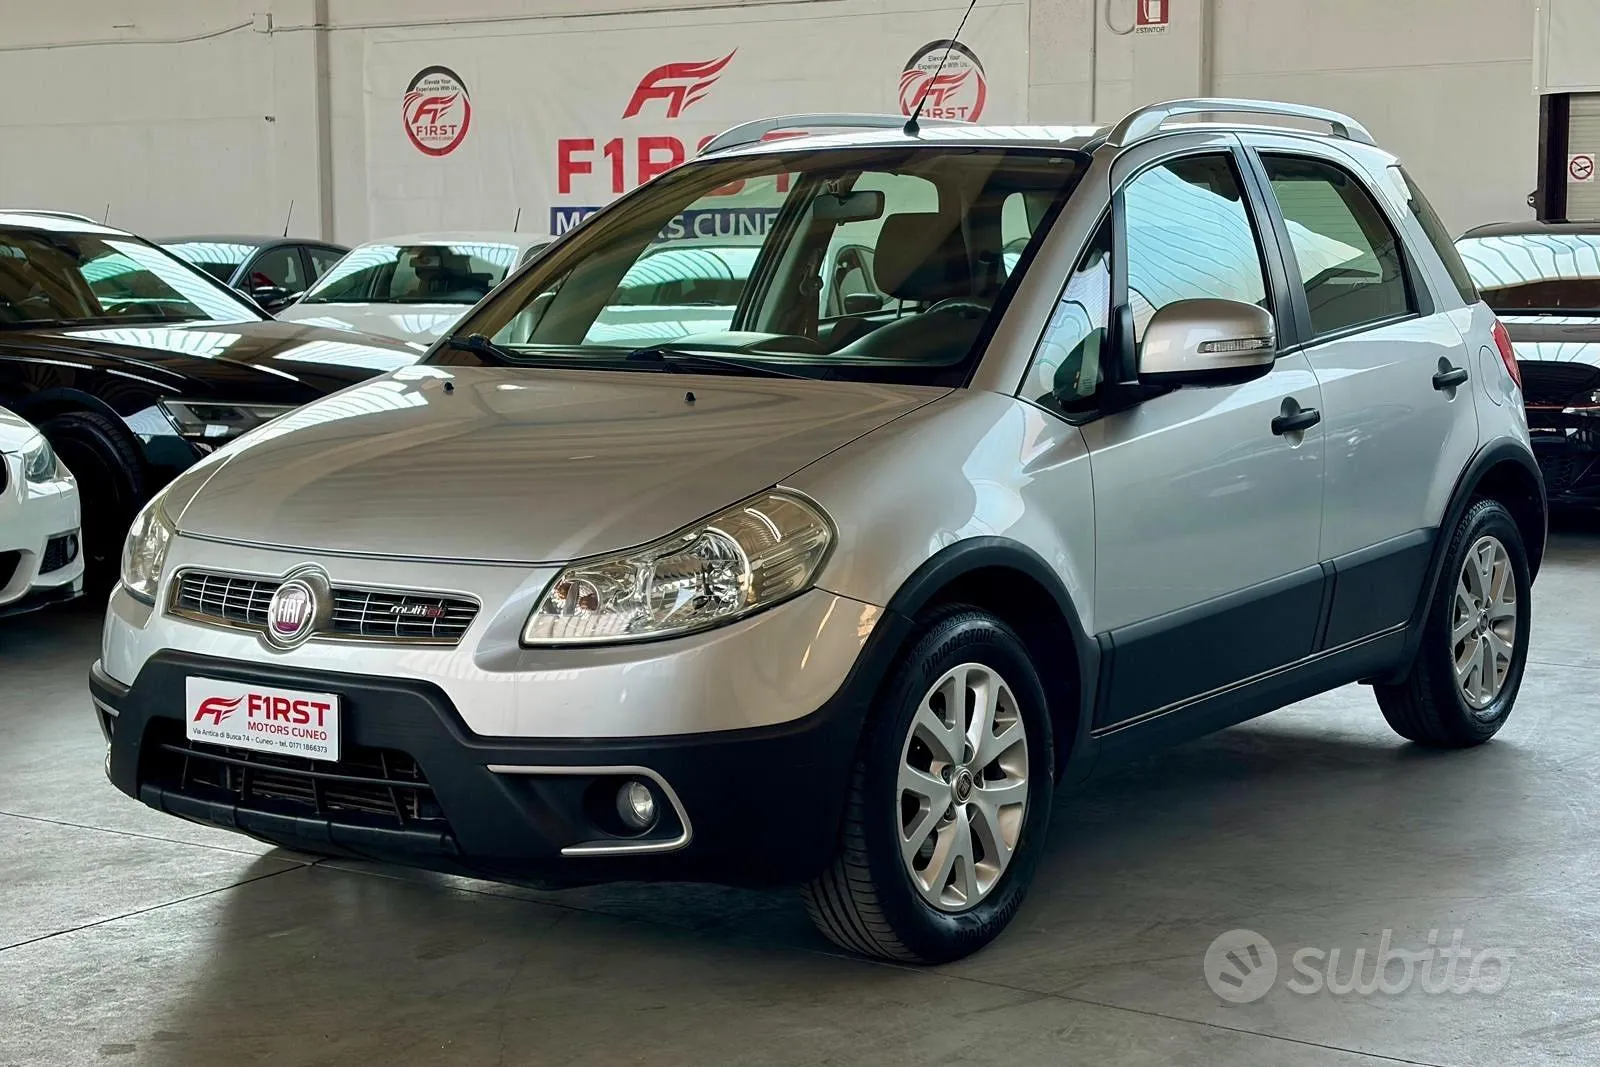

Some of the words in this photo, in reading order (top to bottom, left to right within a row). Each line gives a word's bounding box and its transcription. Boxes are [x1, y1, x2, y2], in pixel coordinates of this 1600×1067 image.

[416, 125, 457, 136] F1RST
[277, 598, 304, 623] FIAT
[248, 694, 330, 726] F1RST
[226, 732, 241, 740] Busca
[255, 737, 274, 745] Cuneo
[248, 722, 289, 735] MOTORS
[292, 728, 327, 740] CUNEO
